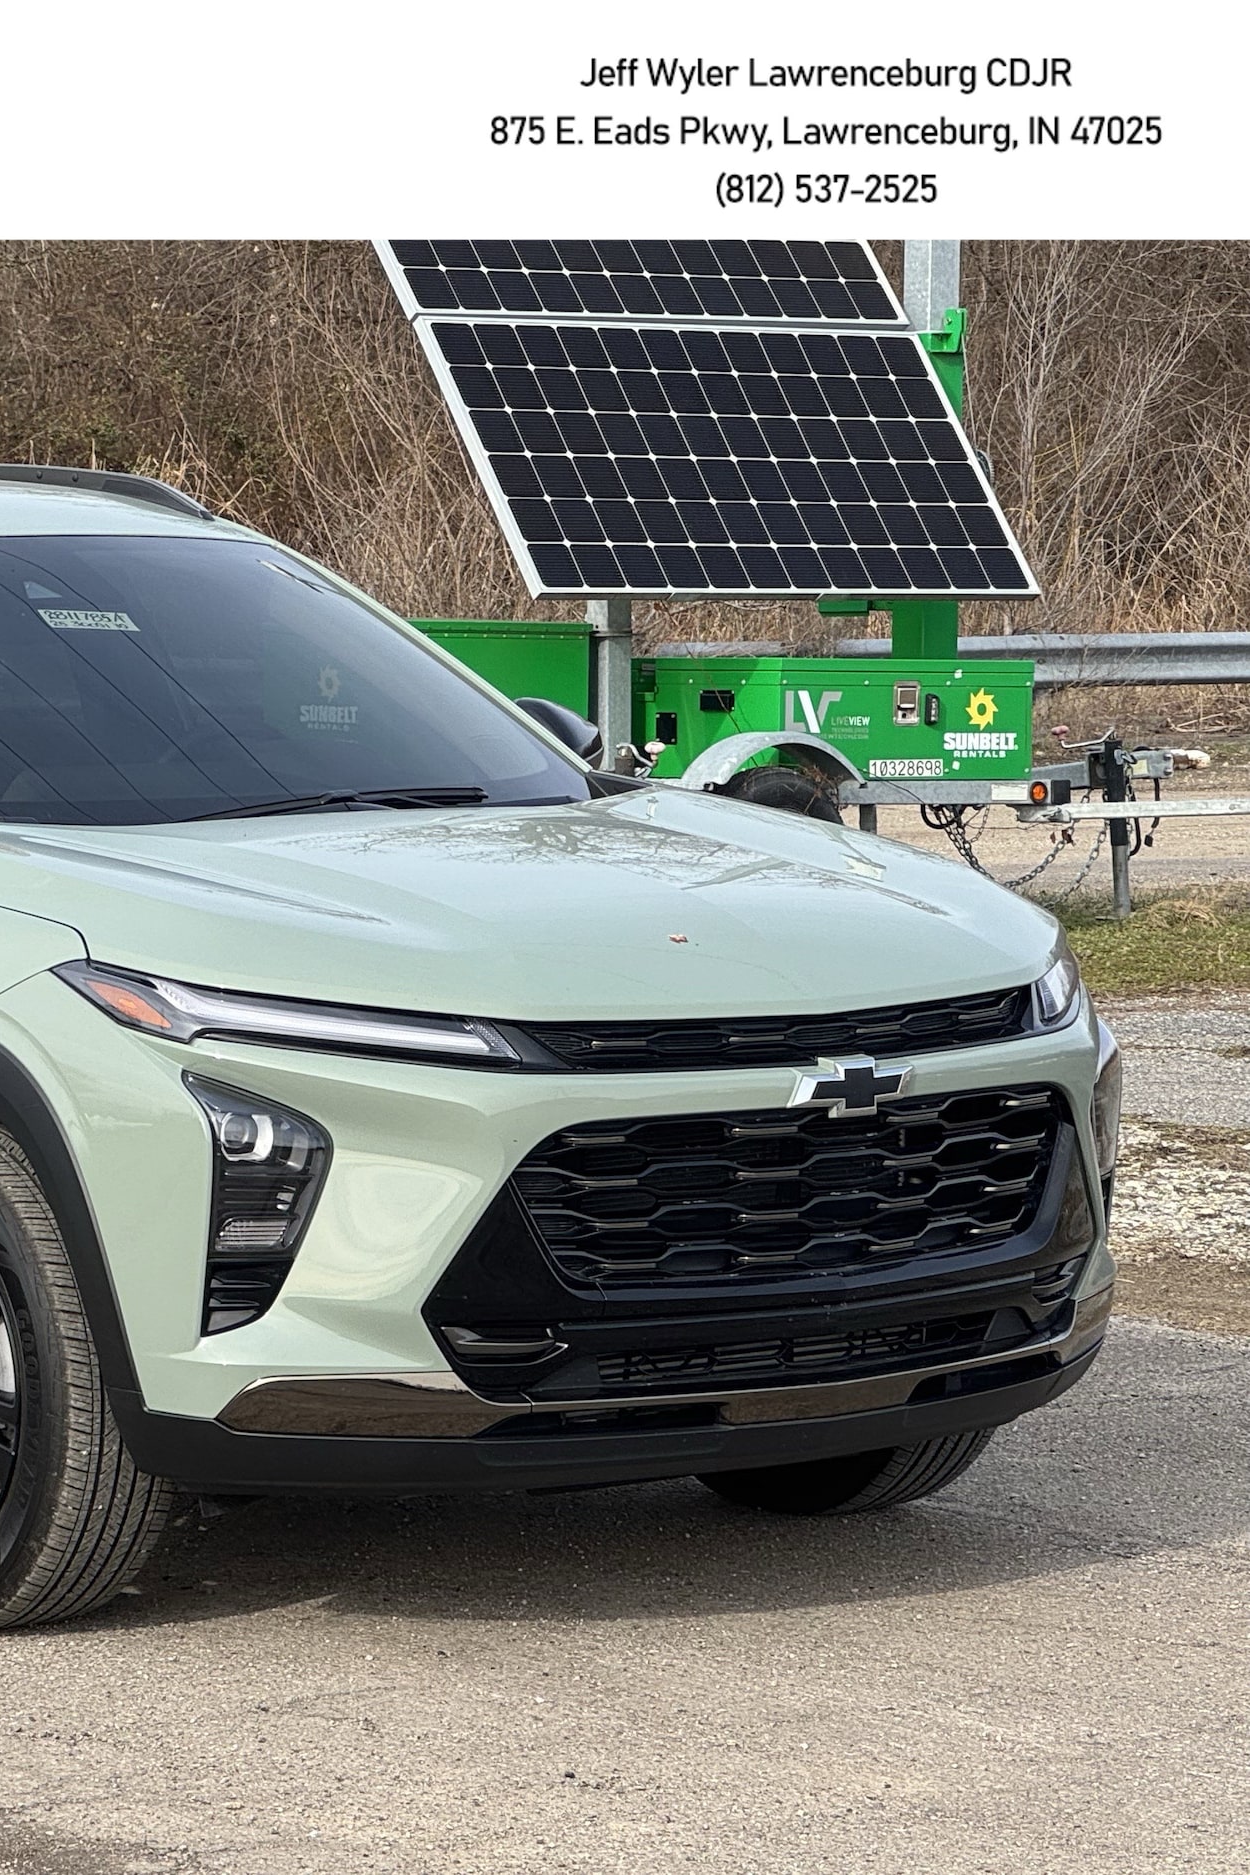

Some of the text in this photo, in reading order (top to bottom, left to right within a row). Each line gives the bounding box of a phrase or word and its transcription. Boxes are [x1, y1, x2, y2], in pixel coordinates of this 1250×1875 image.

[300, 704, 358, 724] SUNBELT
[831, 715, 871, 727] LIVEVIEW
[953, 750, 1007, 758] RENTALS
[871, 760, 942, 776] 10328698
